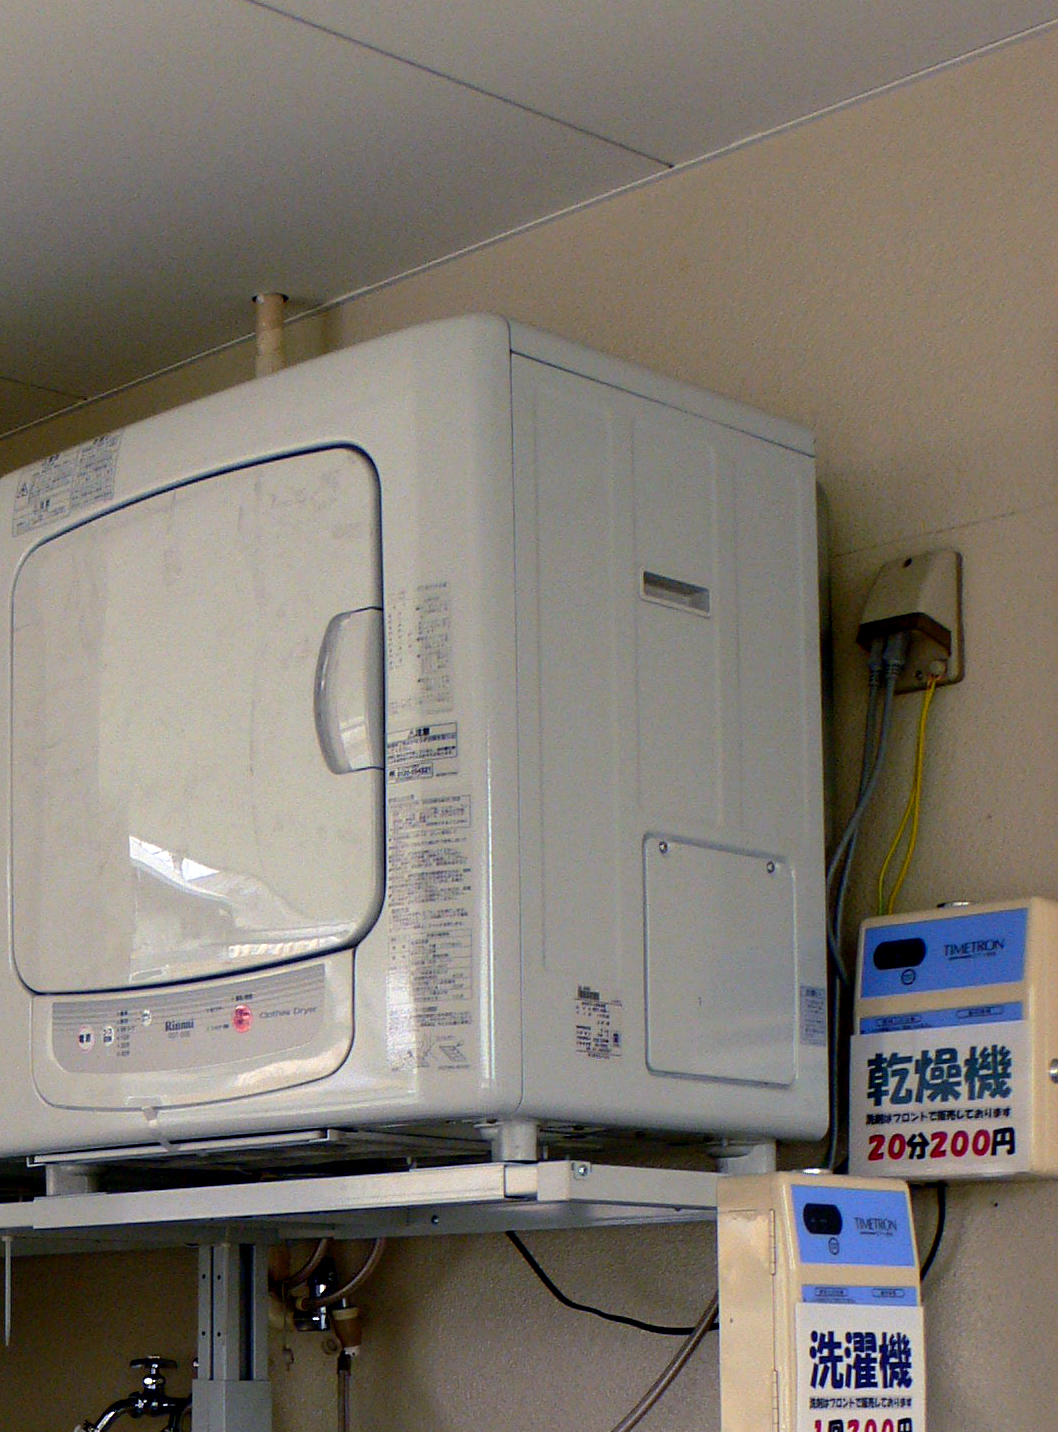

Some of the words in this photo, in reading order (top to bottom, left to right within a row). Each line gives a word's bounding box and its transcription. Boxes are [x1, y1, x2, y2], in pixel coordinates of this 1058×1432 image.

[944, 938, 1005, 957] TIMETRON
[165, 1018, 194, 1032] Rinnai
[867, 1044, 1012, 1106] 乾燥機
[868, 1127, 1015, 1161] 20分200円
[854, 1216, 898, 1231] TIMETRON
[809, 1330, 913, 1389] 洗濯機
